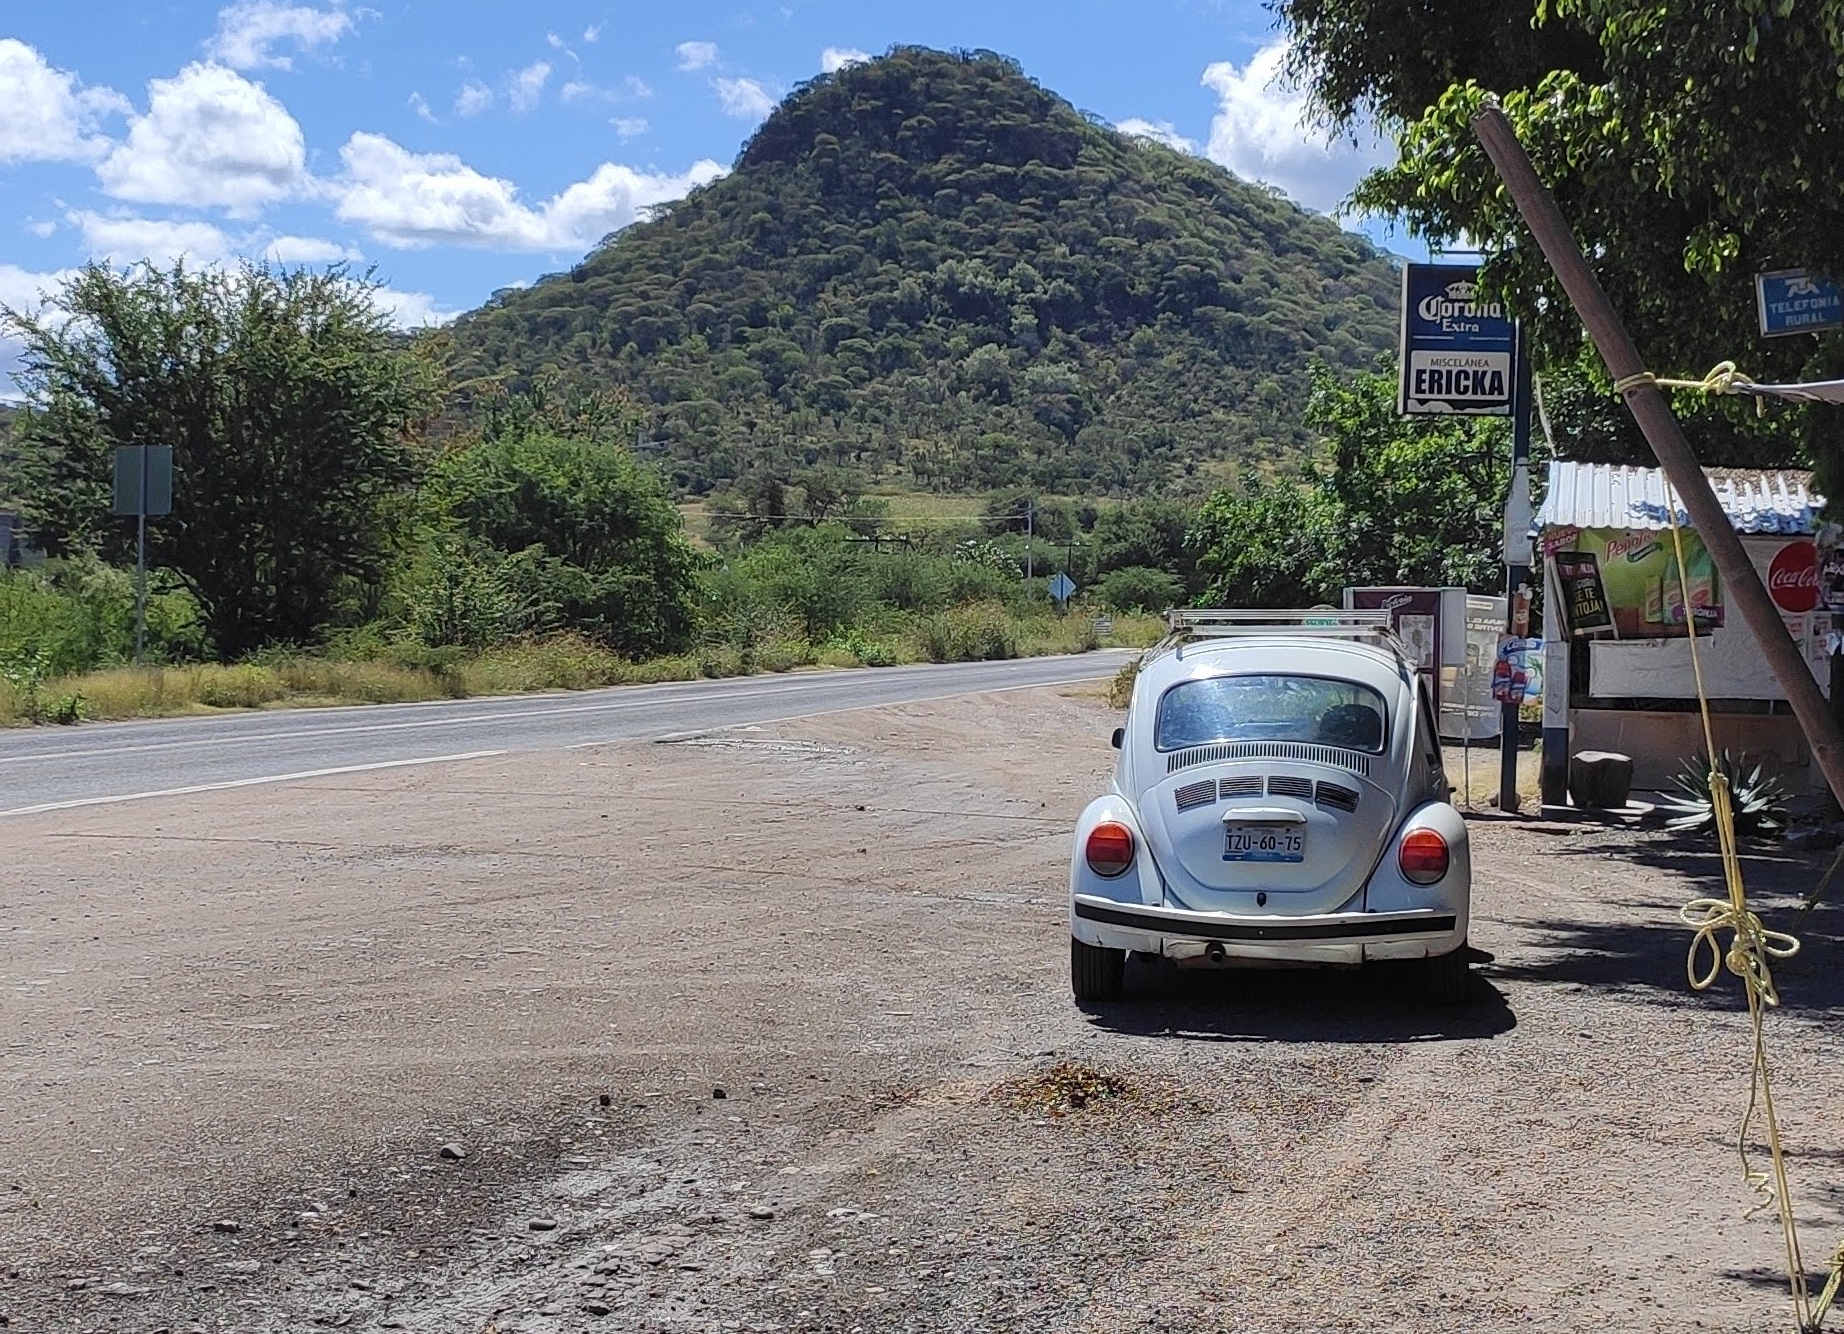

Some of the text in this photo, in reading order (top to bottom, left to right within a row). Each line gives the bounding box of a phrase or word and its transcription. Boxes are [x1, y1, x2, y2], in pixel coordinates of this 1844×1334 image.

[1418, 294, 1502, 324] Corona
[1441, 318, 1480, 333] Extra
[1785, 312, 1827, 327] RURAL
[1430, 357, 1490, 368] MISCELÁNEA
[1414, 368, 1505, 396] ERICKA
[1226, 834, 1302, 851] TZU-60-75
